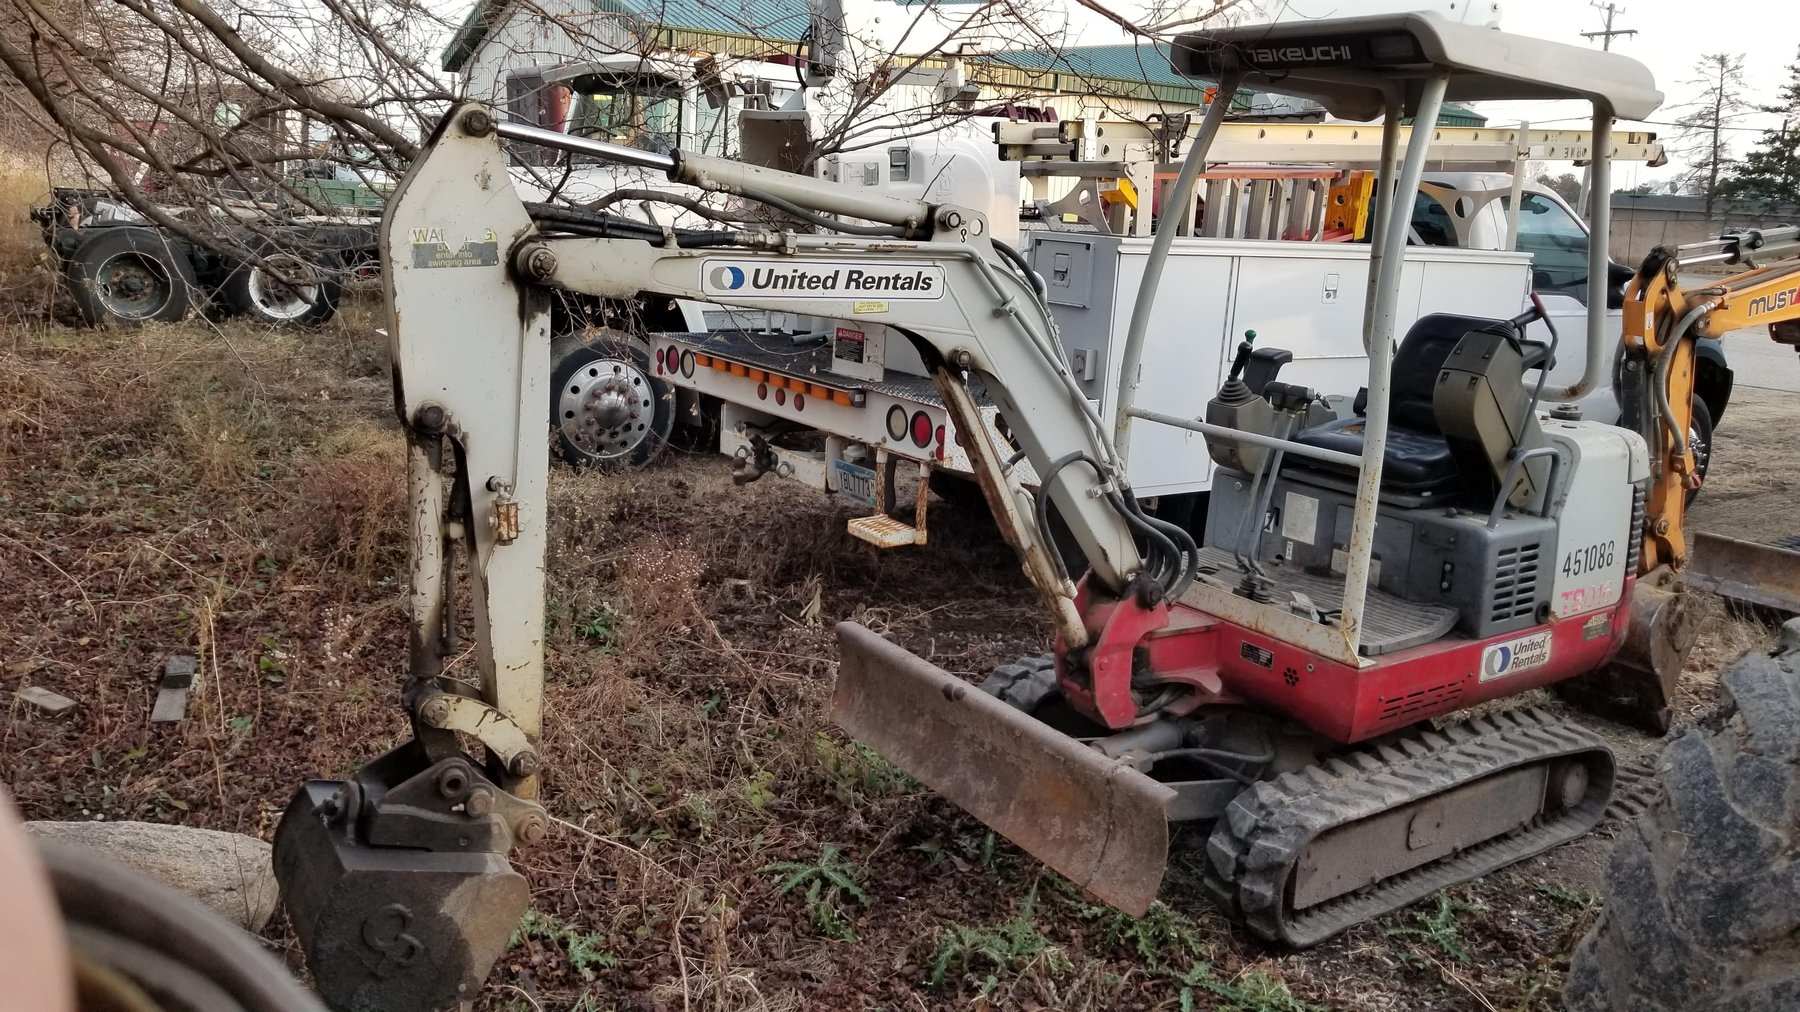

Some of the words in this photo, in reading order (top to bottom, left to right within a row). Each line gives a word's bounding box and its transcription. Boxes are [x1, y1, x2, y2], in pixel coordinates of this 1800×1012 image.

[428, 260, 462, 268] swinging
[752, 268, 840, 290] United
[844, 269, 933, 291] Rentals
[842, 330, 863, 341] DANGER
[1562, 540, 1614, 578] 451088
[1513, 635, 1546, 656] United
[1511, 650, 1547, 670] Rentals
